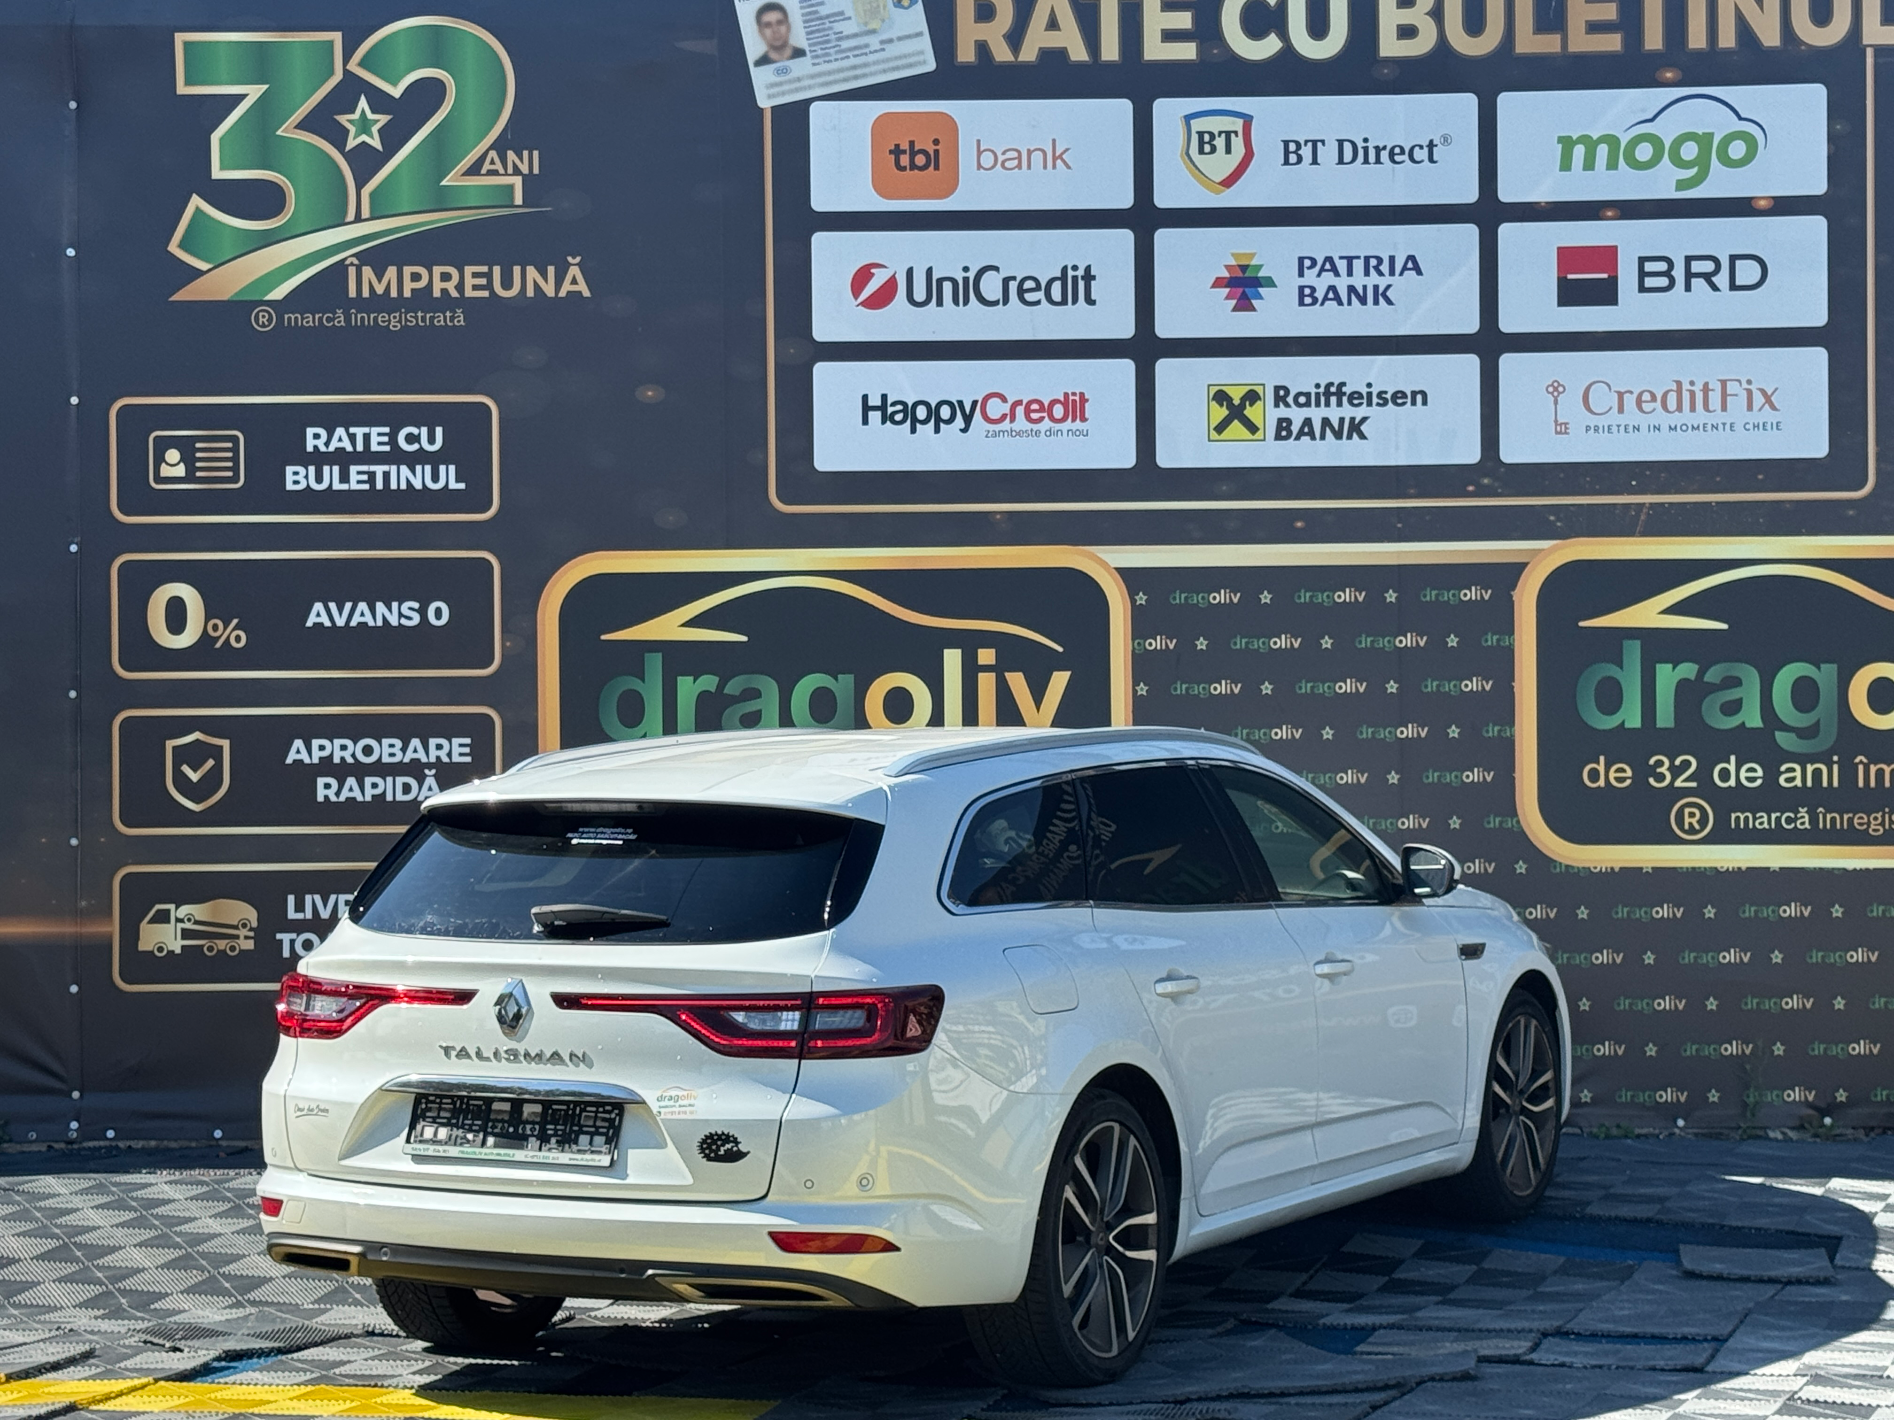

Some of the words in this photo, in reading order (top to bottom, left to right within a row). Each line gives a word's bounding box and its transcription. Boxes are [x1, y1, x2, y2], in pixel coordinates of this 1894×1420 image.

[955, 0, 1198, 63] RATE
[1220, 0, 1349, 61] CU
[889, 138, 941, 172] tbi
[976, 139, 1072, 172] bank
[1196, 130, 1239, 155] BT
[1281, 138, 1326, 167] BT
[481, 149, 540, 175] ANI
[1557, 129, 1759, 192] mogo
[344, 255, 592, 299] ÎMPREUNĂ
[1297, 254, 1424, 278] PATRIA
[1637, 253, 1769, 294] BRD
[906, 264, 1097, 308] UniCredit
[1298, 284, 1396, 307] BANK
[284, 309, 346, 327] marcă
[350, 308, 466, 330] înregistrată
[1273, 381, 1429, 409] Raiffeisen
[1581, 378, 1781, 416] CreditFix
[861, 391, 1089, 435] HappyCredit
[305, 427, 391, 453] RATE
[397, 426, 443, 452] CU
[1044, 425, 1064, 438] din
[1066, 427, 1089, 438] nou
[1273, 416, 1371, 442] BANK
[1585, 423, 1641, 435] PRIETEN
[1647, 423, 1662, 434] IN
[1668, 421, 1737, 434] MOMENTE
[1743, 420, 1783, 432] CHEIE
[285, 464, 466, 491] BULETINUL
[1169, 588, 1241, 608] dragoliv
[1294, 587, 1366, 606] dragoliv
[1420, 586, 1492, 605] dragoliv
[305, 600, 421, 628] AVANS
[426, 600, 450, 627] 0
[1132, 635, 1177, 653] goliv
[1230, 634, 1302, 652] dragoliv
[1355, 632, 1428, 651] dragoliv
[1170, 679, 1242, 698] dragoliv
[1295, 678, 1367, 697] dragoliv
[1421, 676, 1493, 696] dragoliv
[1356, 723, 1429, 742] dragoliv
[285, 737, 472, 765] APROBARE
[1423, 767, 1495, 787] dragoliv
[1582, 755, 1633, 788] de
[1647, 754, 1698, 788] 32
[1713, 755, 1764, 788] de
[1778, 755, 1839, 788] ani
[316, 768, 441, 802] RAPIDĂ
[1730, 807, 1812, 830] marcă
[1612, 903, 1684, 922] dragoliv
[1738, 902, 1812, 921] dragoliv
[1678, 948, 1751, 967] dragoliv
[1805, 947, 1879, 966] dragoliv
[1613, 995, 1687, 1014] dragoliv
[1741, 994, 1814, 1013] dragoliv
[438, 1044, 593, 1069] TALISMAN
[1681, 1039, 1754, 1059] dragoliv
[1808, 1039, 1881, 1058] dragoliv
[1615, 1087, 1688, 1105] dragoliv
